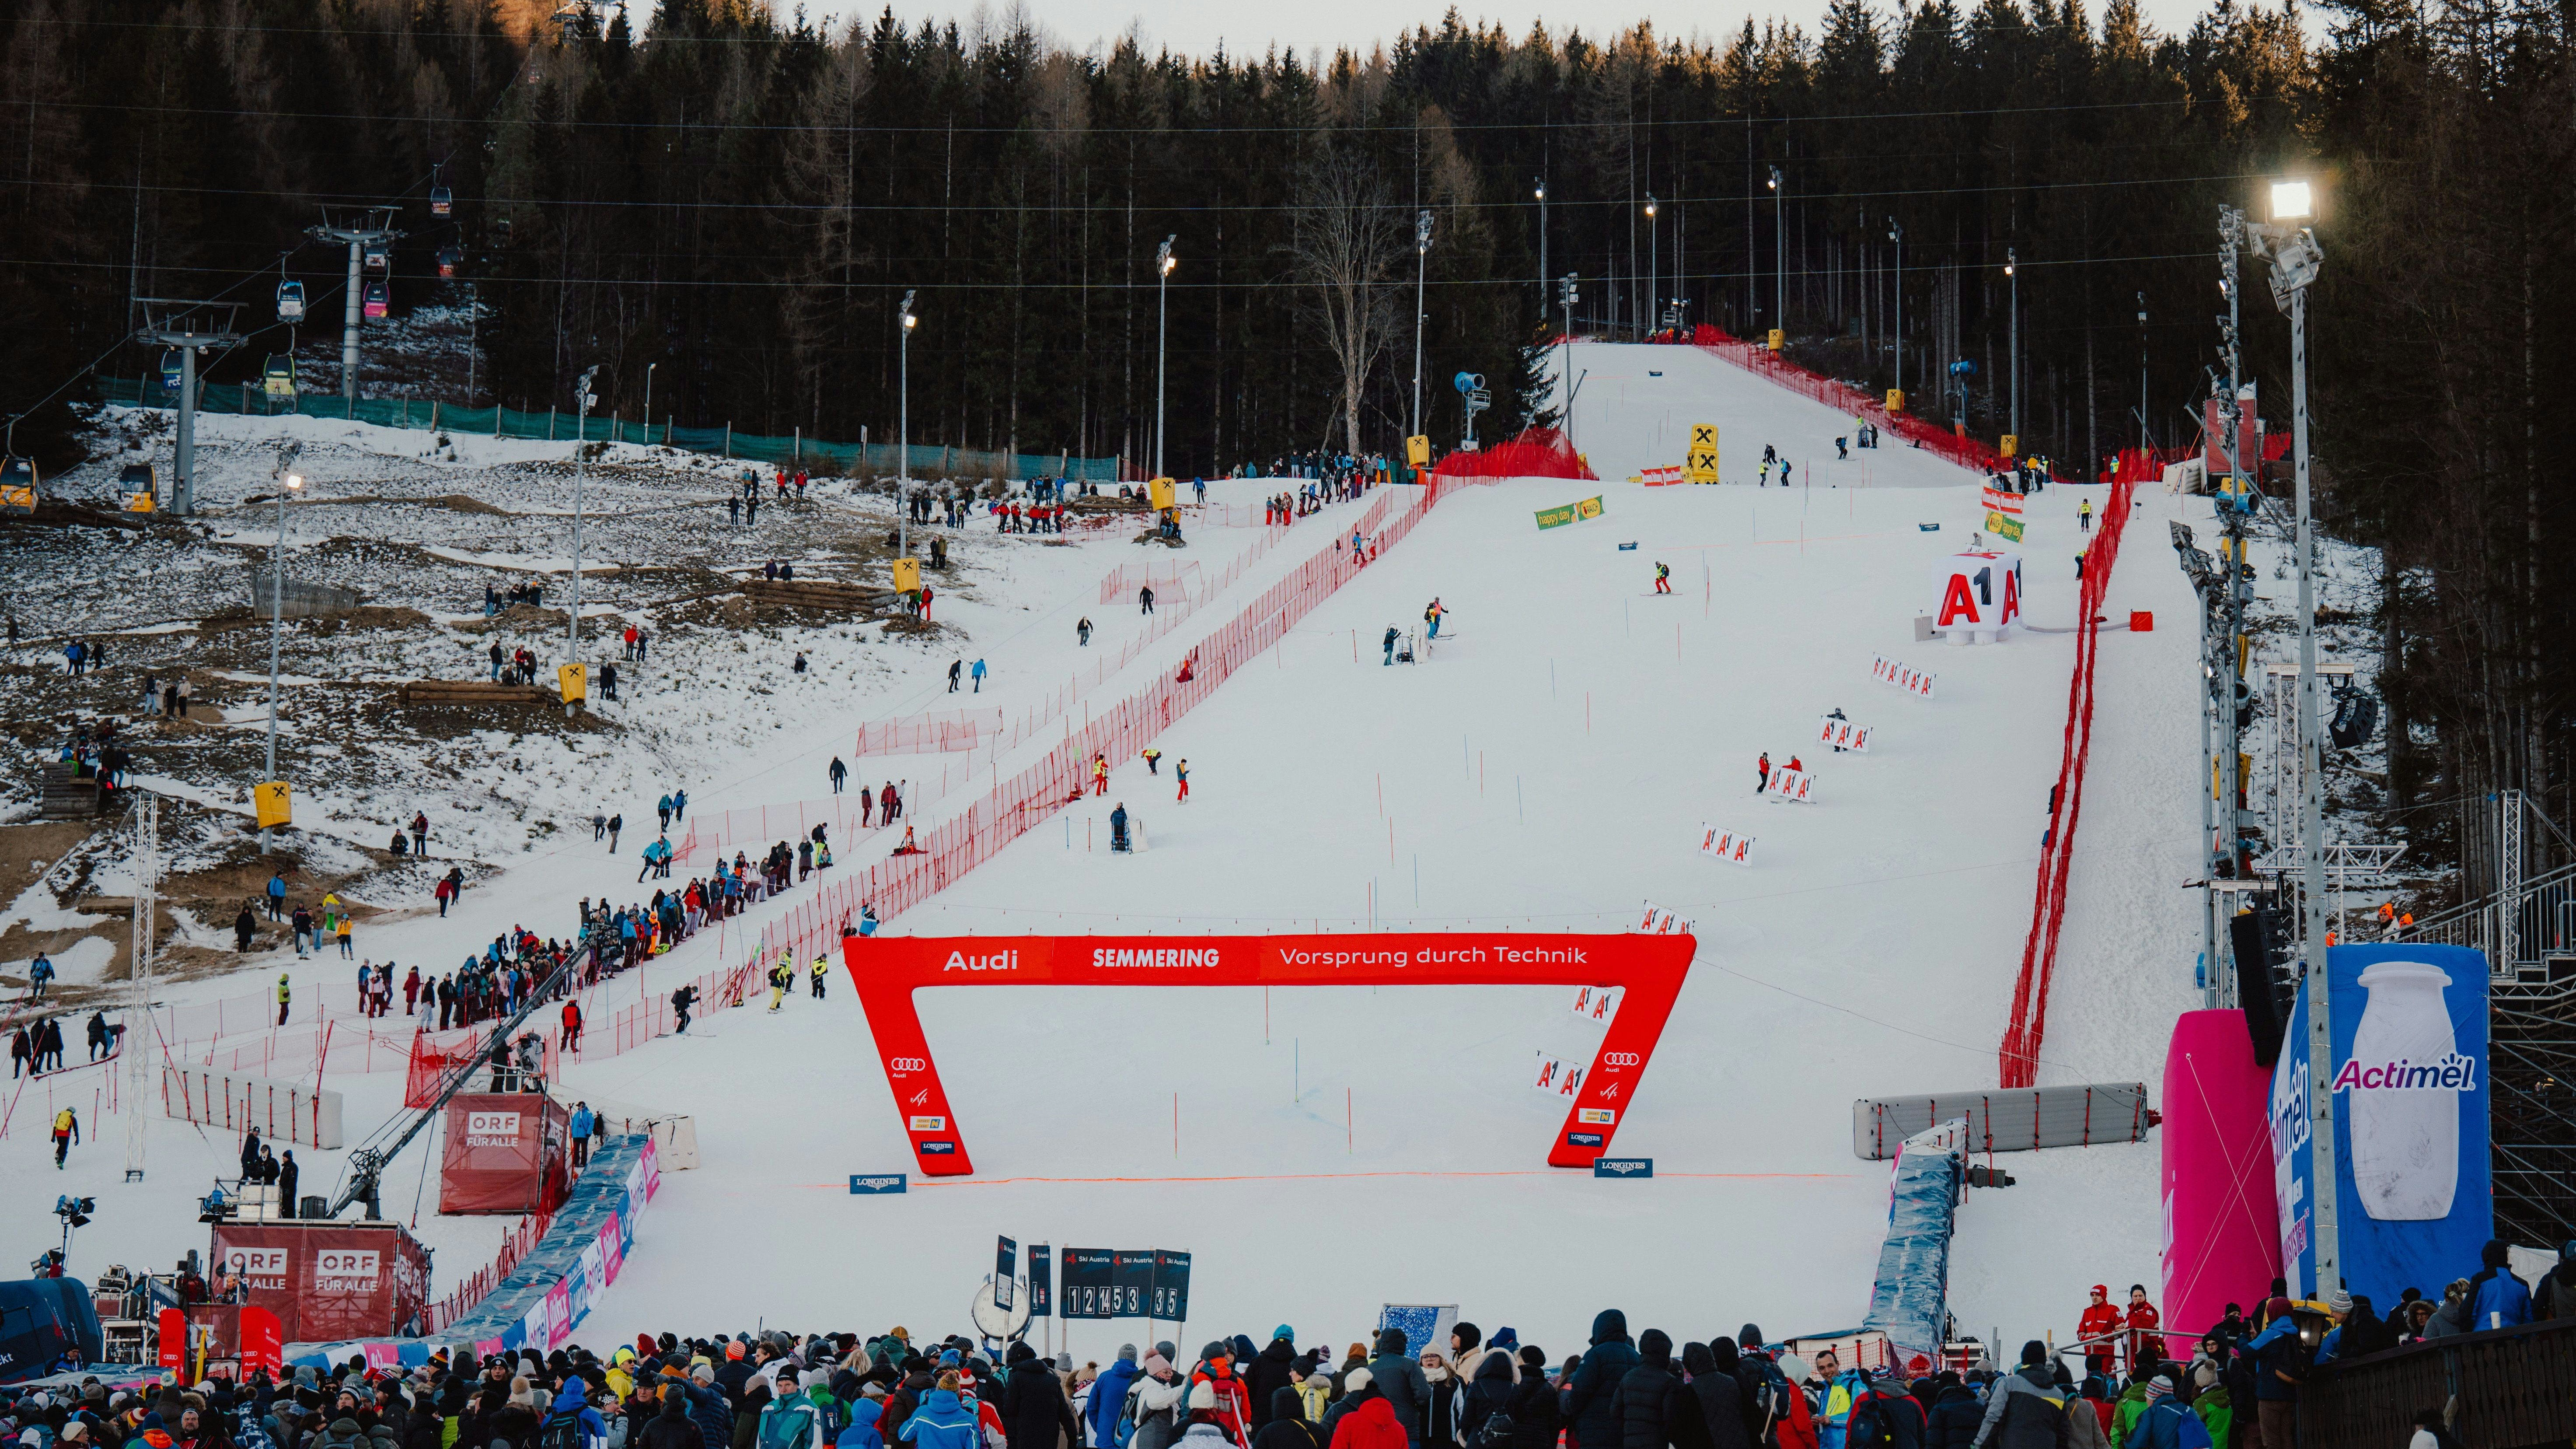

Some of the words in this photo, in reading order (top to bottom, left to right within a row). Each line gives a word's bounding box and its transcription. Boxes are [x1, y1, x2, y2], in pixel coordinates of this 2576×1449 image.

[1538, 513, 1558, 527] happy
[1559, 510, 1570, 522] day
[1587, 503, 1598, 514] RAUCH
[1937, 567, 1991, 626] A1
[2002, 559, 2021, 625] A1
[1887, 663, 1898, 682] A1
[1902, 669, 1911, 687] A1
[1910, 672, 1921, 691] A1
[1921, 675, 1932, 695] A1
[1822, 721, 1834, 740] A1
[1837, 725, 1852, 744] A1
[1853, 729, 1868, 748] A1
[1769, 769, 1781, 790] A1
[1783, 773, 1796, 794] A1
[1798, 777, 1811, 798] A1
[1703, 828, 1716, 850] A1
[1717, 834, 1732, 855] A1
[1734, 839, 1750, 861] A1
[1641, 908, 1659, 930] A1
[1656, 914, 1675, 935] A1
[943, 950, 1018, 971] Audi
[1093, 949, 1219, 967] SEMMERING
[1280, 948, 1408, 967] Vorsprung
[1417, 947, 1486, 963] durch
[1494, 946, 1587, 964] Technik
[1574, 987, 1592, 1012] A1
[1592, 994, 1611, 1019] A1
[1536, 1061, 1558, 1087] A1
[1560, 1068, 1582, 1095] A1
[2333, 1055, 2472, 1090] Actimel
[473, 1117, 516, 1129] ORF
[467, 1135, 488, 1146] FÜR
[489, 1137, 518, 1147] ALLE
[857, 1178, 899, 1186] LONGINES
[230, 1253, 282, 1268] ORF
[323, 1255, 374, 1271] ORF
[251, 1278, 286, 1290] ALLE
[316, 1277, 342, 1290] FÜR
[347, 1280, 378, 1291] ALLE
[1033, 1284, 1037, 1307] 4
[1072, 1289, 1076, 1311] 1
[1086, 1289, 1093, 1312] 2
[1100, 1289, 1110, 1312] 14
[1113, 1288, 1121, 1310] 5
[1130, 1289, 1137, 1311] 3
[1156, 1290, 1162, 1313] 3
[1169, 1291, 1176, 1313] 5
